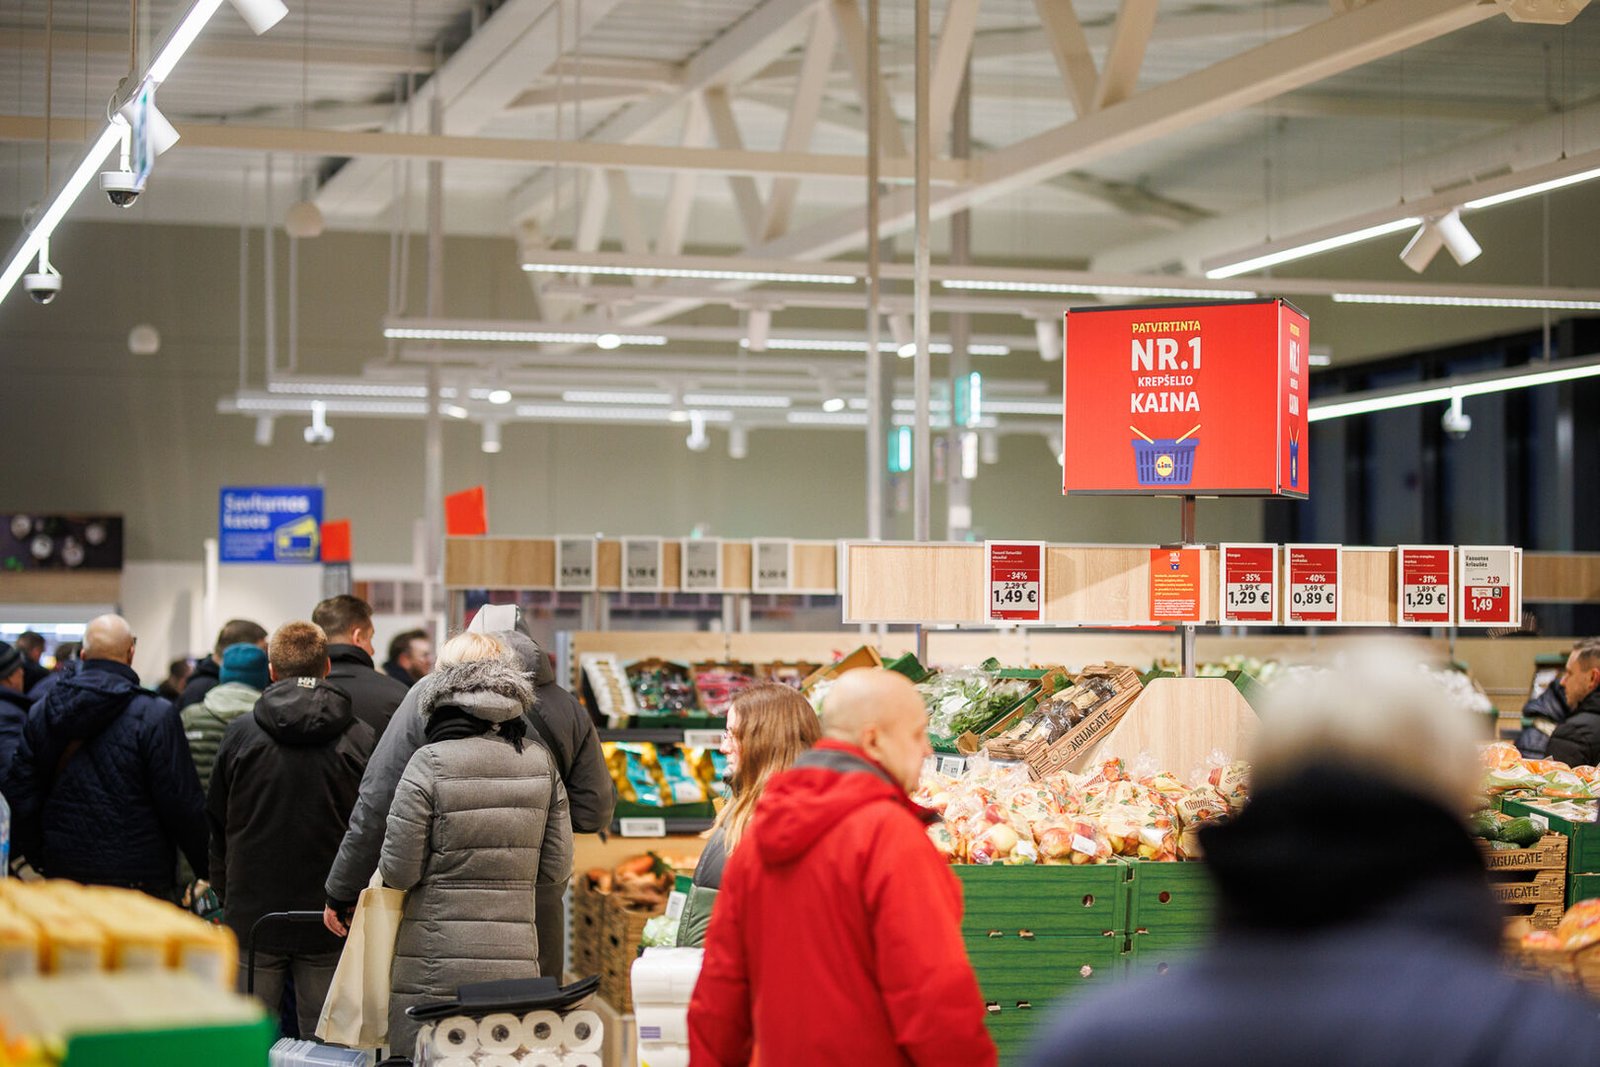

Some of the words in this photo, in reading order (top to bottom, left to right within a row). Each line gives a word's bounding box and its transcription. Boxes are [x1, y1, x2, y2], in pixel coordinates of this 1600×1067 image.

[1132, 320, 1201, 334] PATVIRTINTA
[1131, 336, 1202, 372] NR.1
[1137, 374, 1194, 388] KREPŠELIO
[1130, 391, 1201, 413] KAINA
[1006, 571, 1028, 580] -34%
[1241, 573, 1261, 582] -35%
[1305, 574, 1326, 582] -40%
[994, 590, 1023, 605] 1,49
[1027, 590, 1036, 603] €
[1228, 591, 1256, 606] 1,29
[1261, 591, 1270, 604] €
[1293, 592, 1322, 606] 0,89
[1326, 592, 1334, 604] €
[1406, 593, 1433, 608] 1,29
[1437, 593, 1446, 605] €
[1471, 598, 1493, 613] 1,49
[1070, 709, 1113, 752] AGUACATE
[1491, 852, 1543, 867] AGUACATE
